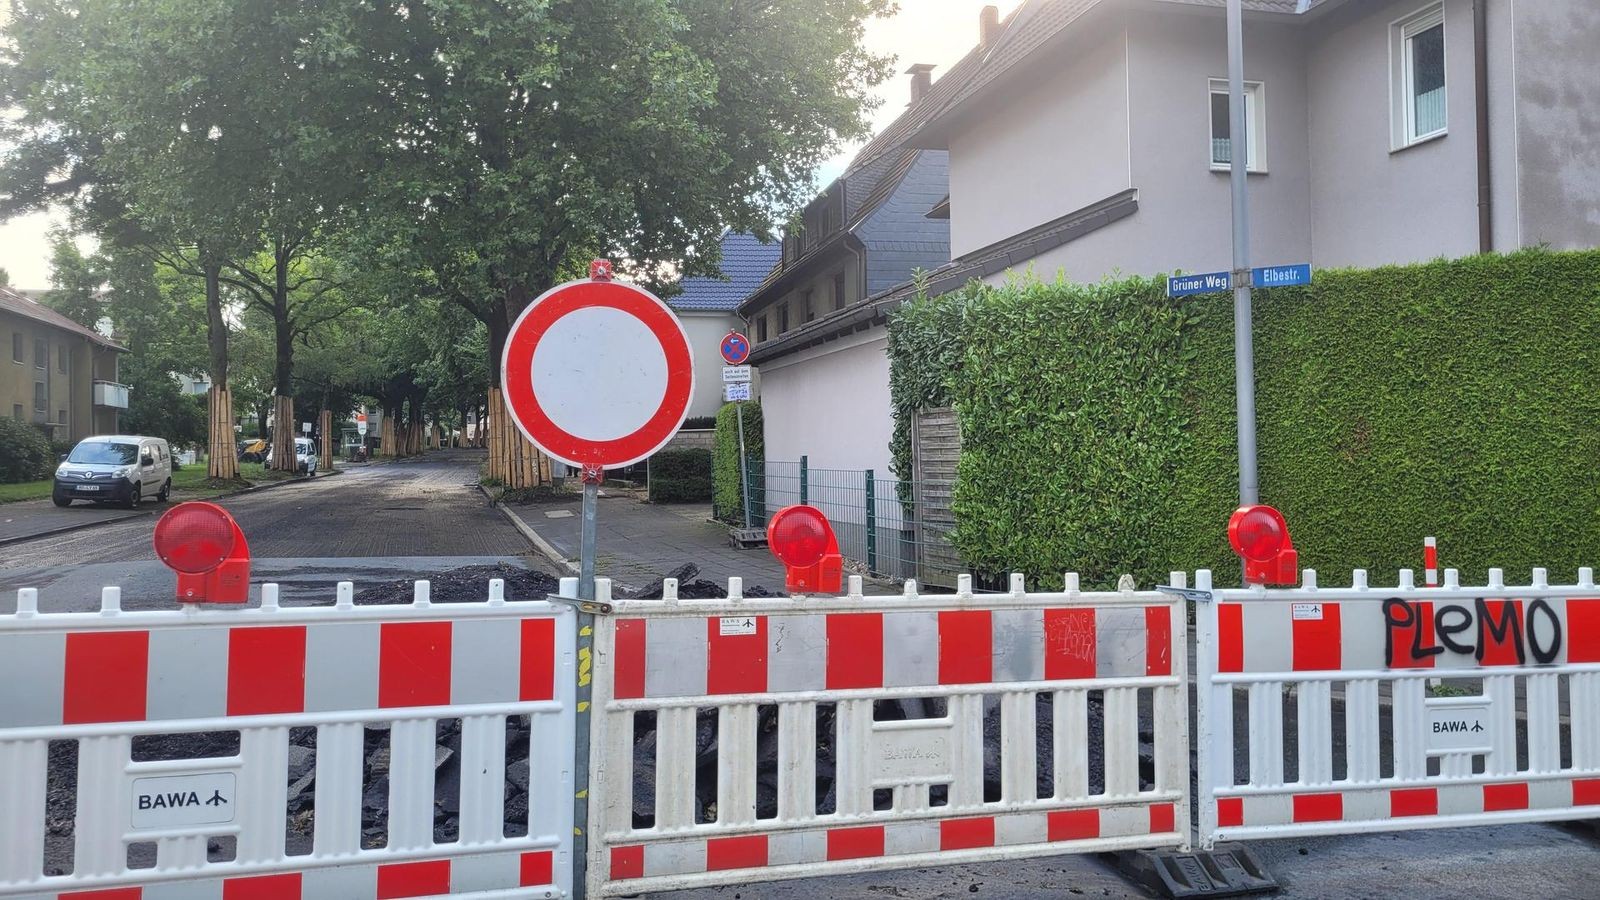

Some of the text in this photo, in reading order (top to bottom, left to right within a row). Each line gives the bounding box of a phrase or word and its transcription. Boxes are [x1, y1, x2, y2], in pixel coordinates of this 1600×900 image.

[1263, 268, 1300, 282] Elbestr.
[1172, 275, 1227, 292] Grüner Weg
[1433, 720, 1468, 733] BAWA
[138, 791, 200, 810] BAWA
